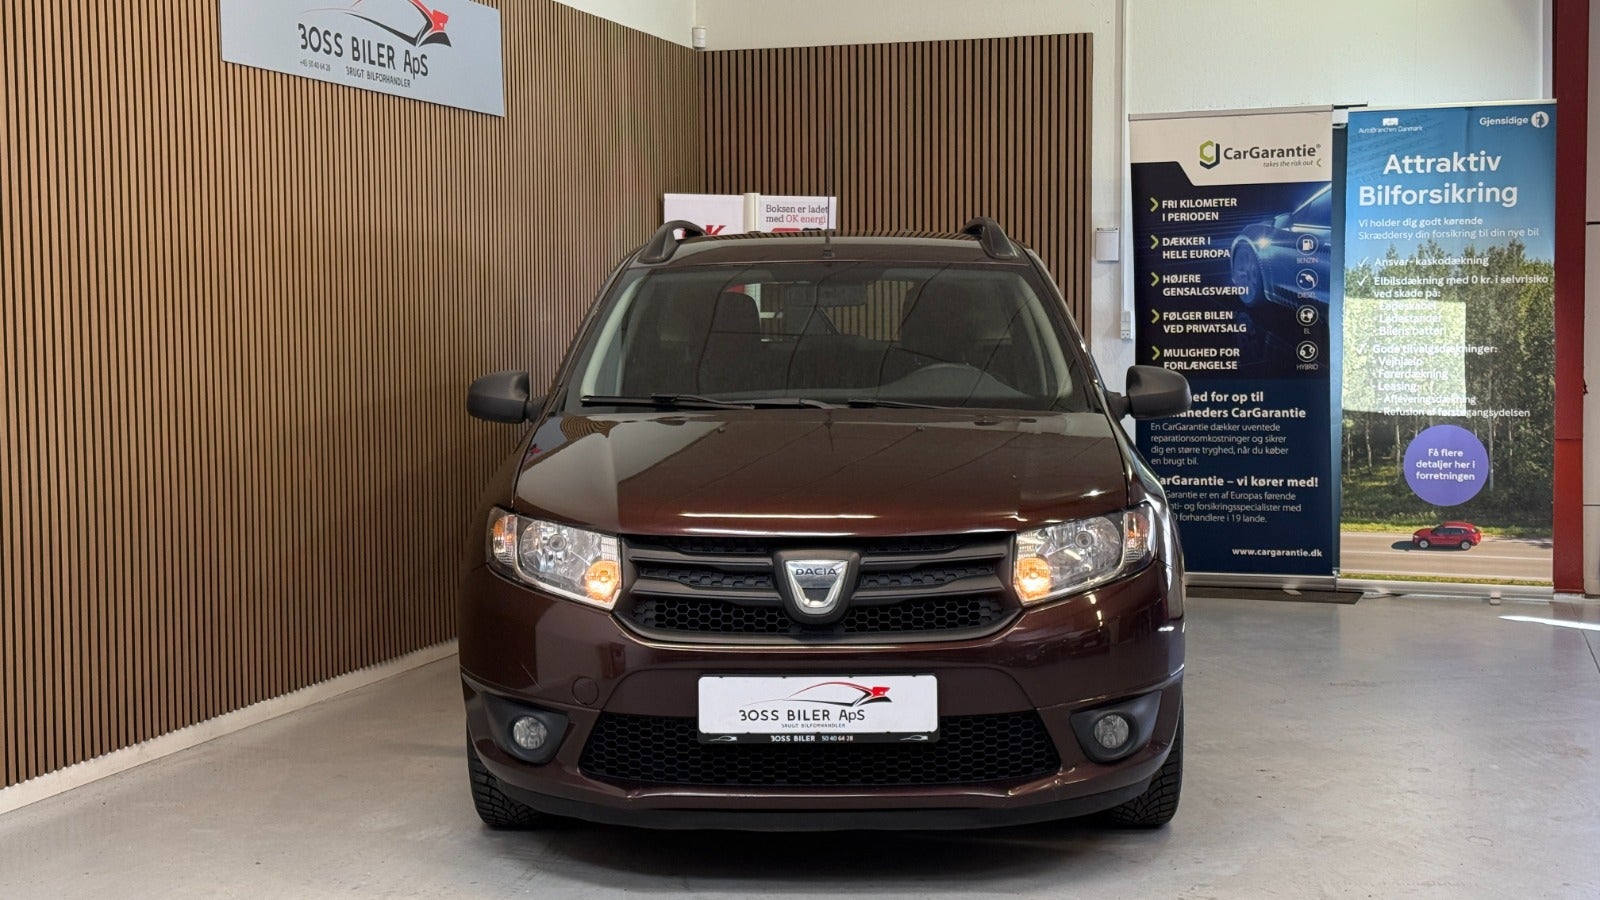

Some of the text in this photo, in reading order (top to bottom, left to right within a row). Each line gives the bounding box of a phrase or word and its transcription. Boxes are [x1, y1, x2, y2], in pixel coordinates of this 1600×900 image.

[351, 36, 396, 70] BILER
[403, 49, 429, 79] ApS
[366, 70, 411, 88] BILFORHANDLER
[1479, 116, 1529, 128] Gjensidige
[1383, 151, 1502, 174] Attraktiv
[1358, 182, 1518, 208] Bilforsikring
[1162, 197, 1237, 209] FRI KILOMETER
[765, 204, 829, 214] Boksen er ladet
[765, 214, 827, 225] med OK energi
[1162, 211, 1219, 222] I PERIODEN
[1358, 216, 1484, 229] Vi holder dig godt kørende
[1358, 228, 1539, 241] Skræddersy din forsikring til din nye bil
[1162, 236, 1210, 246] DÆKKER I
[1162, 249, 1230, 259] HELE EUROPA
[1415, 256, 1489, 267] kaskodækning
[1163, 274, 1201, 283] HØJERE
[1374, 274, 1548, 287] Elbilsdækning med 0 kr. i selvrisiko
[1163, 286, 1249, 297] GENSALGSVÆRDI
[1373, 288, 1441, 299] ved skade på:
[1163, 311, 1233, 321] FØLGER BILEN
[1163, 323, 1247, 334] VED PRIVATSALG
[1380, 326, 1410, 336] Bilens
[1163, 348, 1240, 358] MULIGHED FOR
[1372, 344, 1401, 354] Gode
[1164, 360, 1238, 370] FORLÆNGELSE
[1378, 369, 1448, 380] Førerdækning
[1211, 391, 1229, 402] for
[1231, 394, 1248, 404] op
[1251, 391, 1264, 402] til
[1231, 408, 1306, 418] CarGarantie
[1383, 406, 1425, 416] Refusion
[1150, 422, 1280, 431] En CarGarantie dækker uventede
[1151, 434, 1287, 444] reparationsomkostninger og sikrer
[1150, 445, 1164, 456] dig
[1178, 446, 1201, 454] større
[1202, 445, 1236, 456] tryghed,
[1237, 445, 1250, 454] når
[1252, 446, 1264, 455] du
[1265, 446, 1289, 455] køber
[1428, 448, 1464, 457] Få flere
[1163, 457, 1186, 467] brugt
[1186, 457, 1199, 465] bil.
[1416, 460, 1475, 470] detaljer her i
[1158, 475, 1224, 486] arGarantie
[1236, 476, 1248, 486] vi
[1251, 476, 1284, 487] kører
[1287, 476, 1319, 488] med!
[1416, 472, 1475, 482] forretningen
[1165, 490, 1198, 499] Garantie
[1221, 491, 1229, 500] af
[1230, 491, 1263, 501] Europas
[1264, 492, 1296, 501] førende
[1183, 504, 1195, 512] og
[1196, 502, 1281, 513] forsikringsspecialister
[1282, 504, 1302, 512] med
[1180, 513, 1225, 522] forhandlere
[1226, 514, 1230, 522] i
[1231, 514, 1241, 523] 19
[1242, 514, 1268, 523] lande.
[1232, 548, 1323, 558] www.cargarantie.dk
[795, 568, 837, 576] DACIA
[787, 710, 831, 721] BILER
[839, 710, 865, 724] ApS
